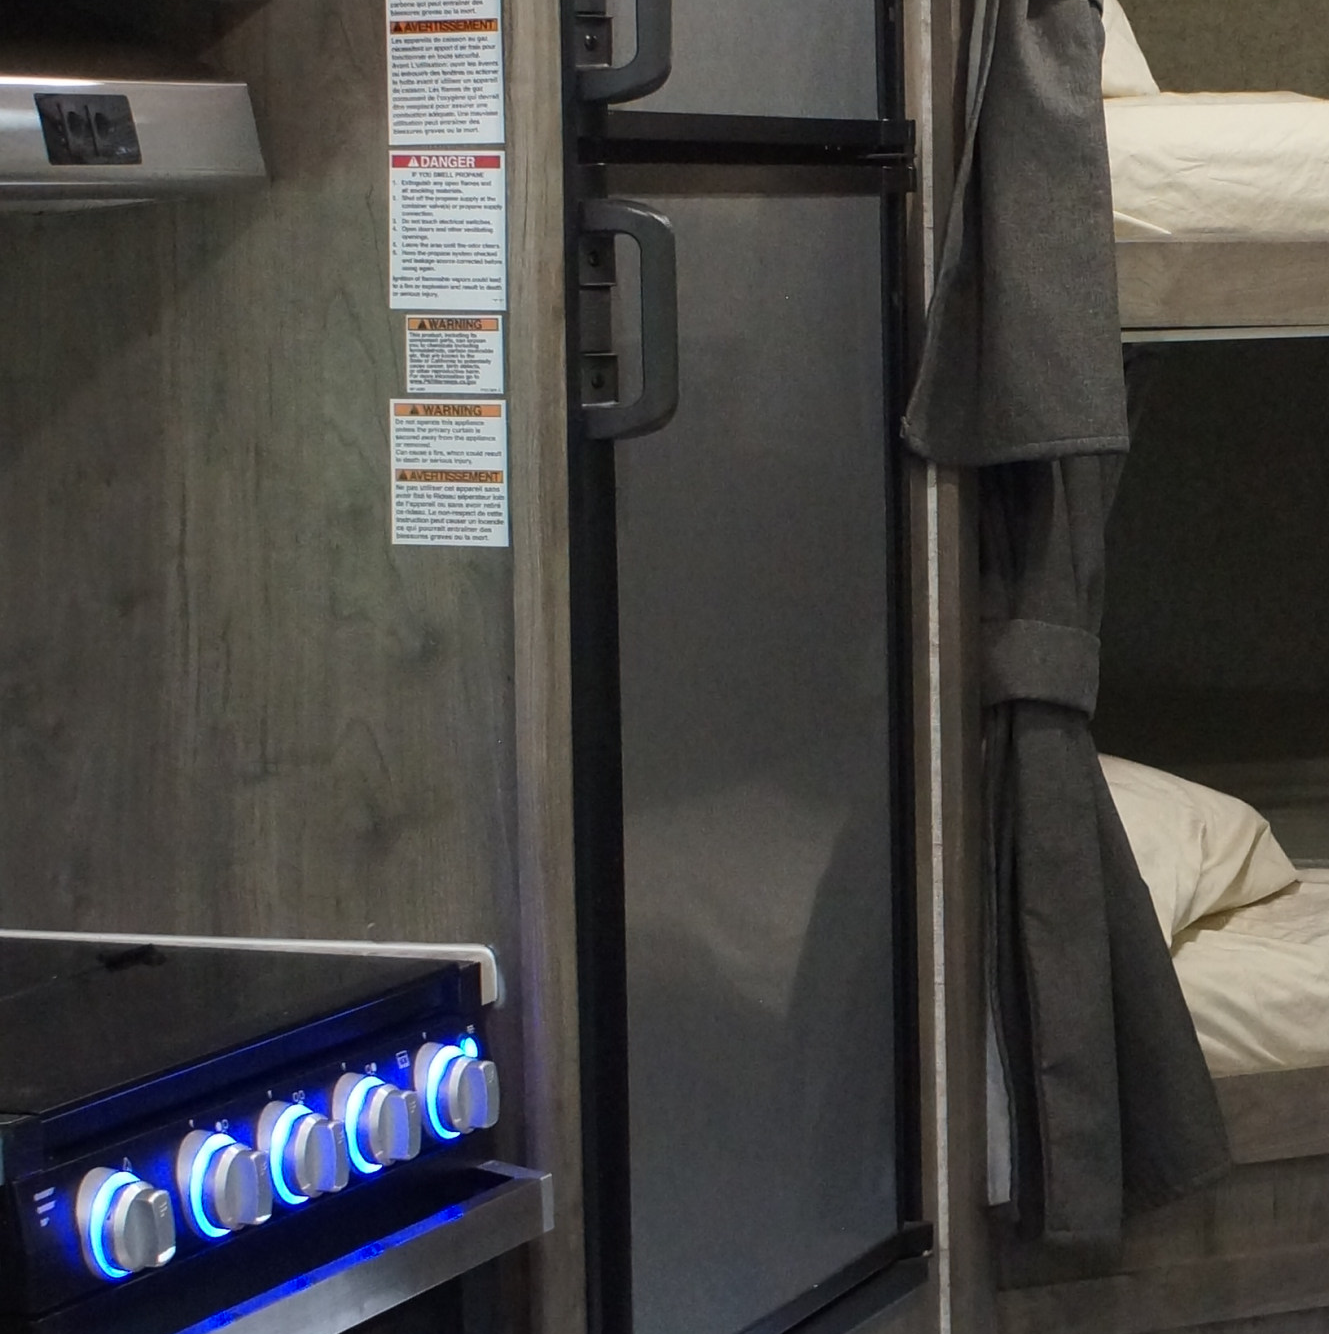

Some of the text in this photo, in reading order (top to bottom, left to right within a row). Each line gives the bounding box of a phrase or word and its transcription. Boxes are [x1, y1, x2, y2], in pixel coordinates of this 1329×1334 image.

[404, 20, 495, 32] AVERTISSEMENT
[421, 156, 475, 167] DANGER
[430, 319, 482, 329] WARNING
[423, 405, 482, 416] WARNING
[410, 471, 498, 482] AVERTISSEMENT
